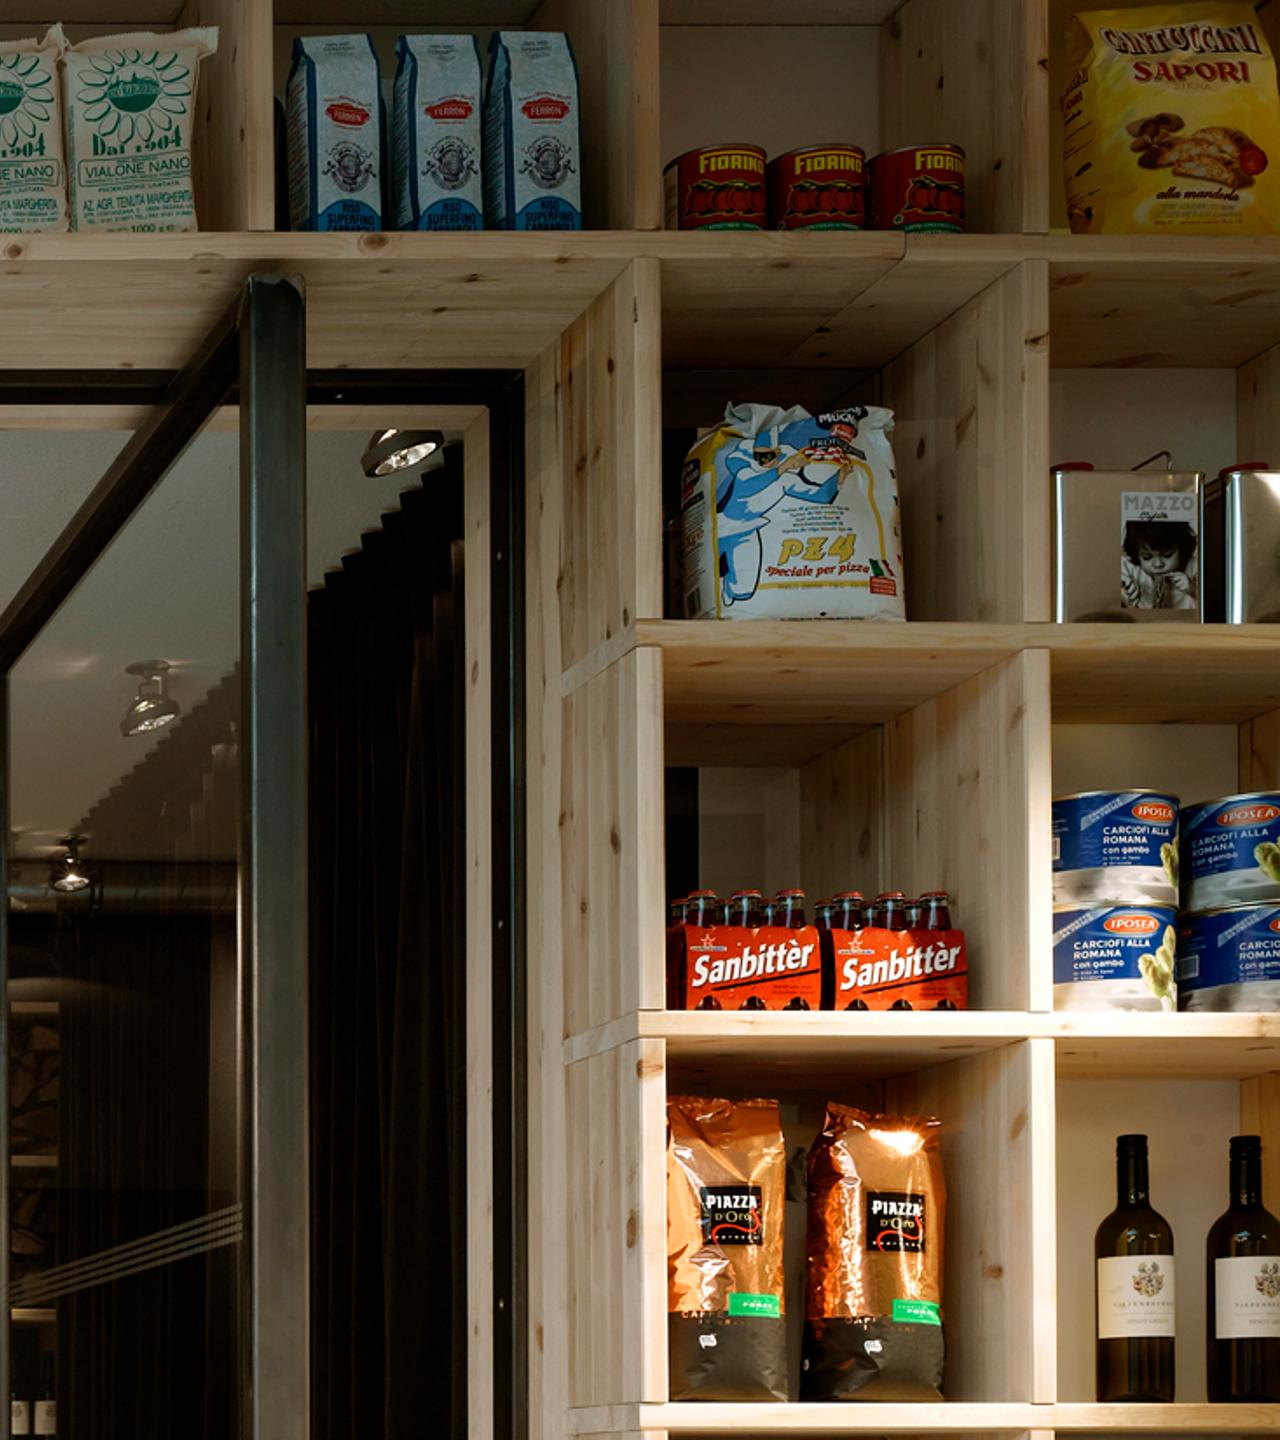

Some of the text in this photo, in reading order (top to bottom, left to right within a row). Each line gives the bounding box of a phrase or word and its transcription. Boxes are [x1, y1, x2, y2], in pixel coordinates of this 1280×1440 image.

[1101, 24, 1263, 56] CANTUCCINI
[1133, 60, 1251, 85] SAPORI
[84, 156, 191, 179] VIALONE NANO
[699, 150, 765, 175] FIORINO
[794, 150, 863, 176] FIORINO
[13, 165, 55, 180] NANO
[1124, 495, 1195, 511] MAZZO
[765, 561, 870, 579] speciale per pizza
[1222, 808, 1276, 824] IPOSEA
[1102, 825, 1170, 837] CARCIOFI ALLA
[1192, 828, 1269, 850] CARCIOFI ALLA
[1103, 835, 1148, 845] ROMANA
[1103, 846, 1150, 857] con gambo
[1192, 842, 1236, 858] ROMANA
[1110, 917, 1156, 931] IPOSEA
[1073, 939, 1151, 952] CARCIOFI ALLA
[691, 938, 815, 988] Sanbittèr
[1073, 949, 1122, 961] ROMANA
[839, 940, 961, 992] Sanbittèr
[1073, 959, 1126, 973] con gambo
[1239, 963, 1257, 974] con
[705, 1194, 758, 1215] PIAZZA
[870, 1199, 923, 1217] PIAZZA
